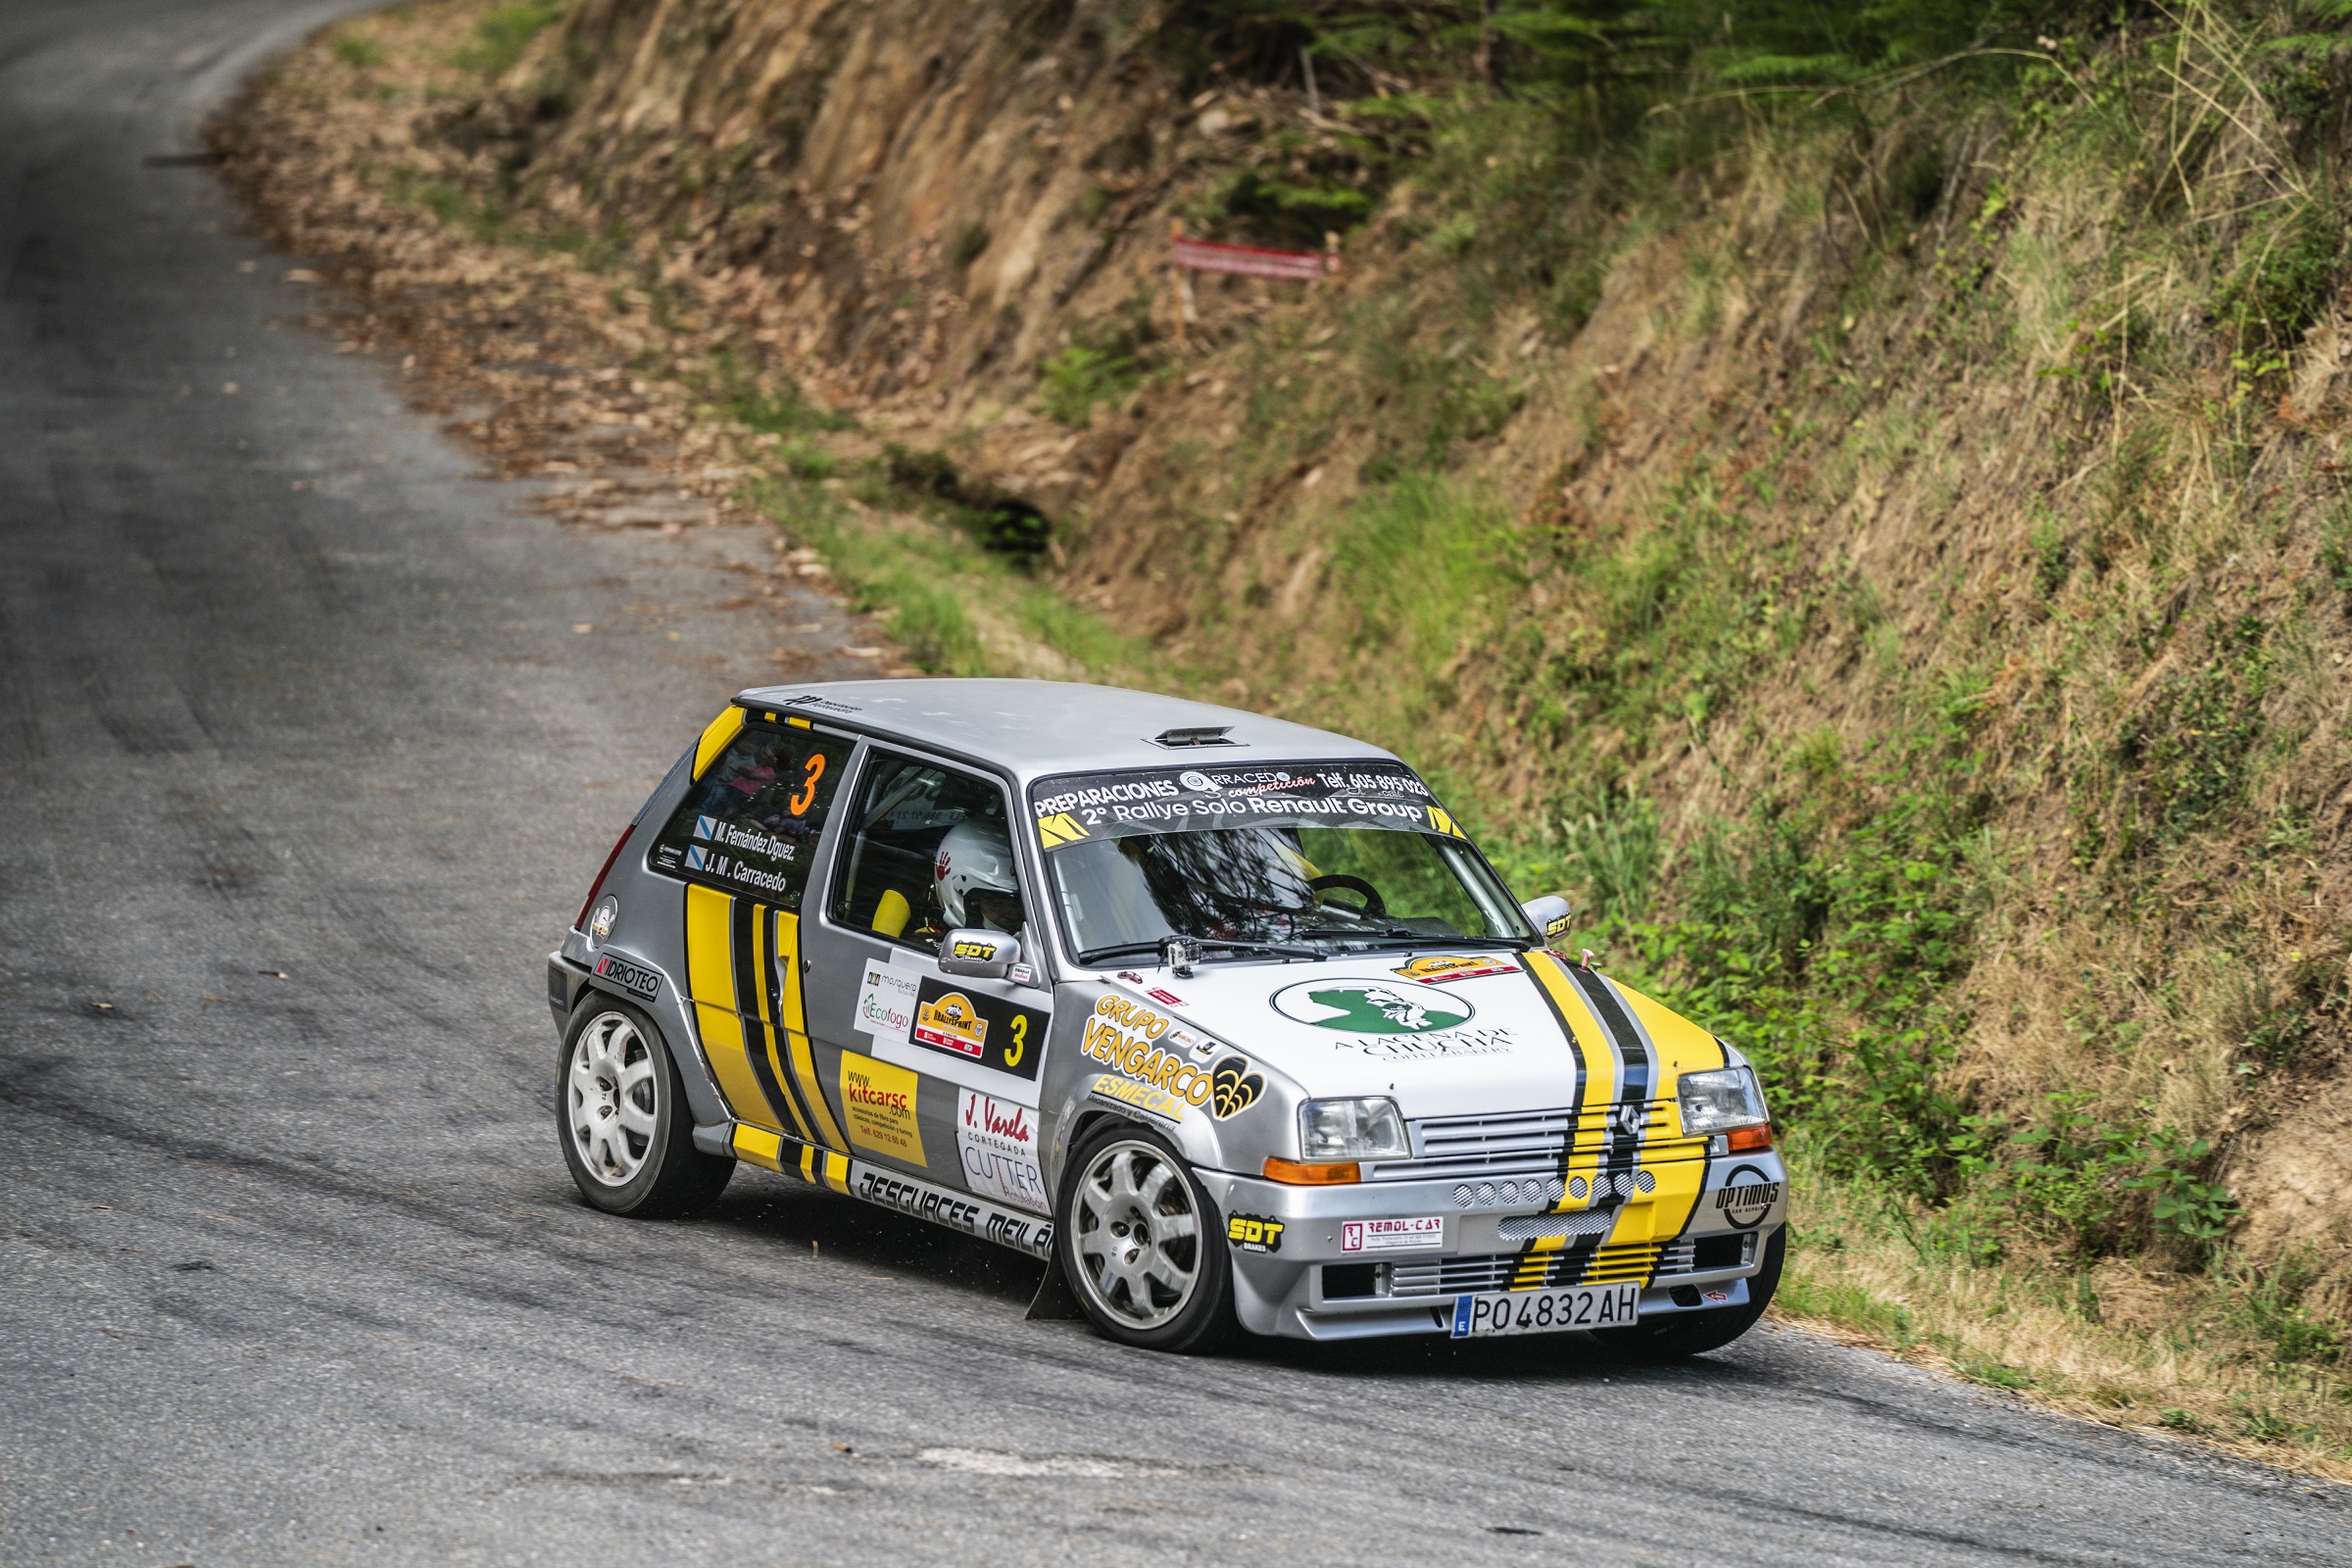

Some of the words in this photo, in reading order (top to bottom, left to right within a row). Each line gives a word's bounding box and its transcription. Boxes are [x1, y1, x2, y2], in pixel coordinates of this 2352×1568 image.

[790, 754, 826, 816] 3
[1034, 779, 1179, 818] PREPARACIONES
[1316, 772, 1349, 788] Telf.
[1349, 773, 1377, 789] 605
[1376, 775, 1403, 791] 895
[1402, 779, 1429, 797] 023
[1112, 801, 1189, 819] Rallye
[1193, 799, 1247, 814] Solo
[1247, 797, 1348, 814] Renault
[1348, 799, 1422, 822] Group
[714, 821, 724, 842] M.
[725, 824, 770, 853] Fernández
[766, 834, 795, 861] Dguez.
[706, 853, 714, 872] J.
[733, 860, 786, 892] Carracedo
[954, 944, 997, 957] SDT
[881, 975, 917, 993] mosquera
[1097, 995, 1169, 1040] GRUPO
[1004, 1014, 1028, 1067] 3
[1363, 1037, 1513, 1054] CHUCHA
[1082, 1018, 1213, 1106] VENGARCO
[848, 1070, 871, 1088] www.
[850, 1083, 907, 1109] kitcarsc
[1087, 1094, 1126, 1113] Mecanizado
[1093, 1073, 1186, 1120] ESMECAL
[889, 1104, 910, 1120] .com
[965, 1094, 977, 1128] J.
[985, 1096, 1029, 1142] Varela
[968, 1132, 1026, 1156] CORTEGADA
[965, 1147, 1042, 1196] CUTTER
[859, 1172, 980, 1234] DESGUACES
[986, 1212, 1054, 1257] MEILÁ
[1368, 1218, 1440, 1233] REMOL-CAR
[1228, 1217, 1284, 1246] SDT
[1244, 1243, 1266, 1252] BRAKES
[1458, 1321, 1466, 1332] E
